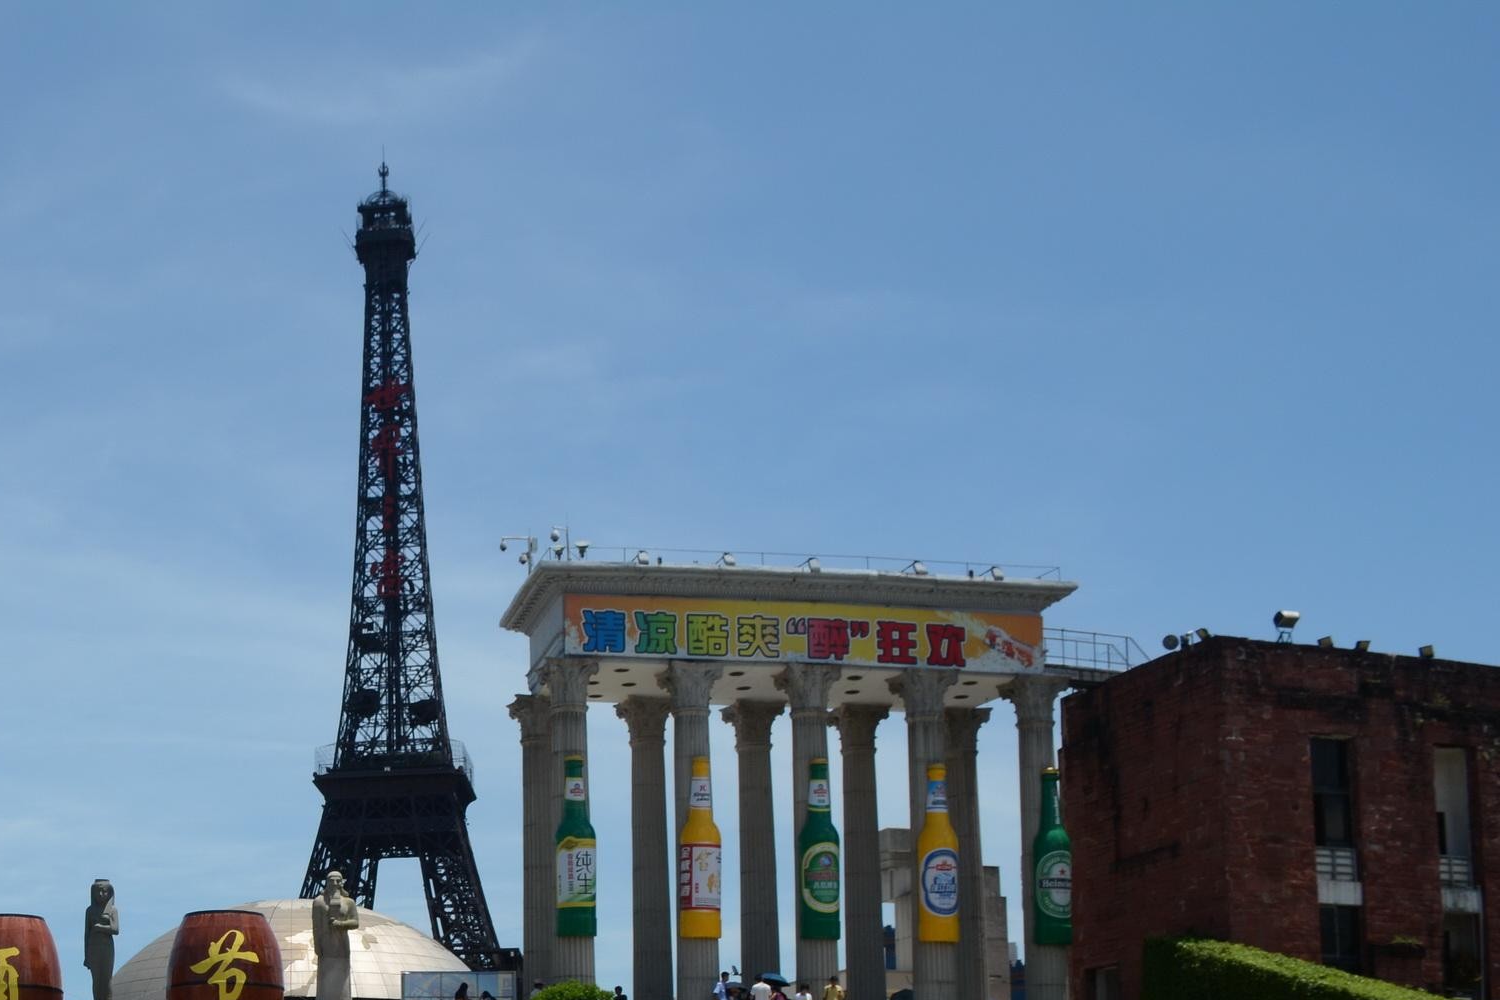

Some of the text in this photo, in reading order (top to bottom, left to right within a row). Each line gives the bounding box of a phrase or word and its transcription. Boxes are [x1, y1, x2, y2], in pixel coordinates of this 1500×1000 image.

[582, 608, 966, 668] 清凉酷爽“醉”狂欢
[576, 850, 592, 895] 纯生
